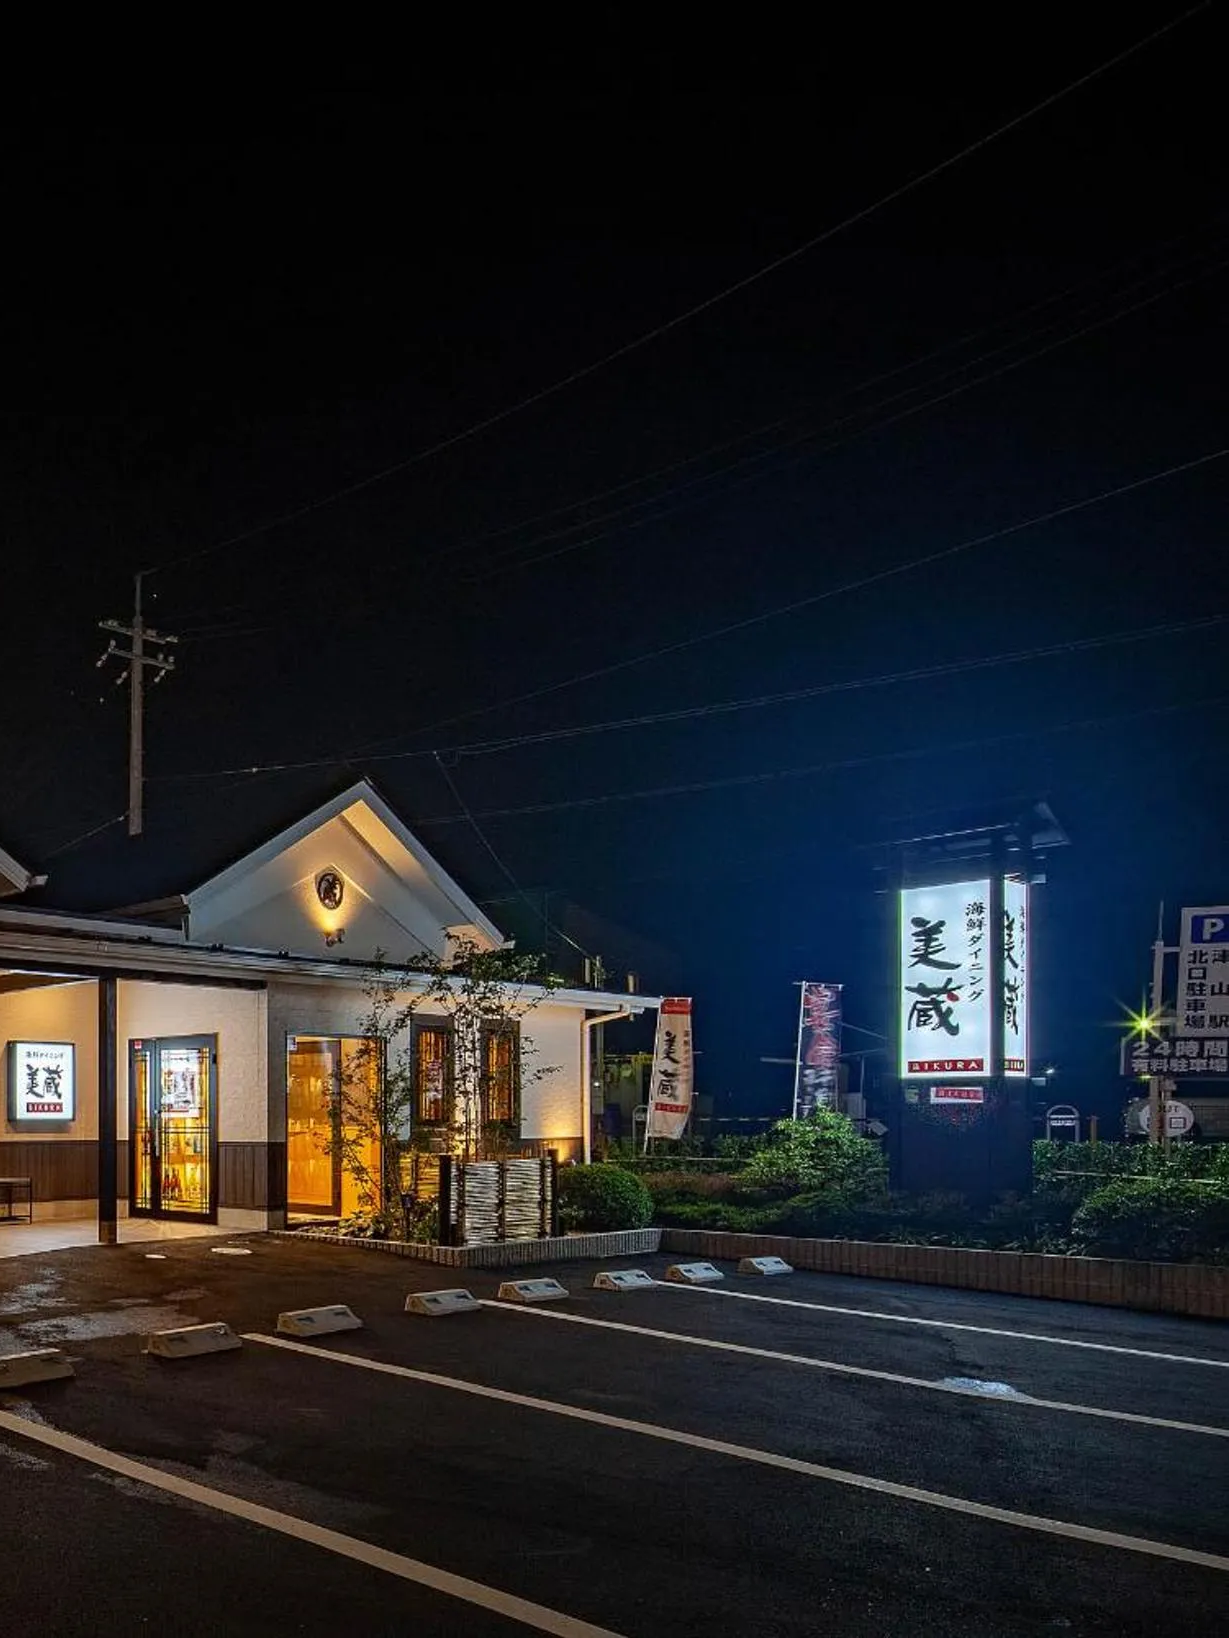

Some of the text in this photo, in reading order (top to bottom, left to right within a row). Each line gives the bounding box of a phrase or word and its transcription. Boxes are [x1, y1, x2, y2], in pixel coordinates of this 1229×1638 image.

[1202, 918, 1225, 941] P
[965, 902, 987, 1002] 海鮮ダイニング
[904, 917, 962, 1036] 美蔵
[1184, 950, 1209, 1030] 北口駐車場
[1131, 1058, 1228, 1073] 有料駐車場
[1132, 1040, 1228, 1058] 24時間
[26, 1064, 64, 1100] 美蔵
